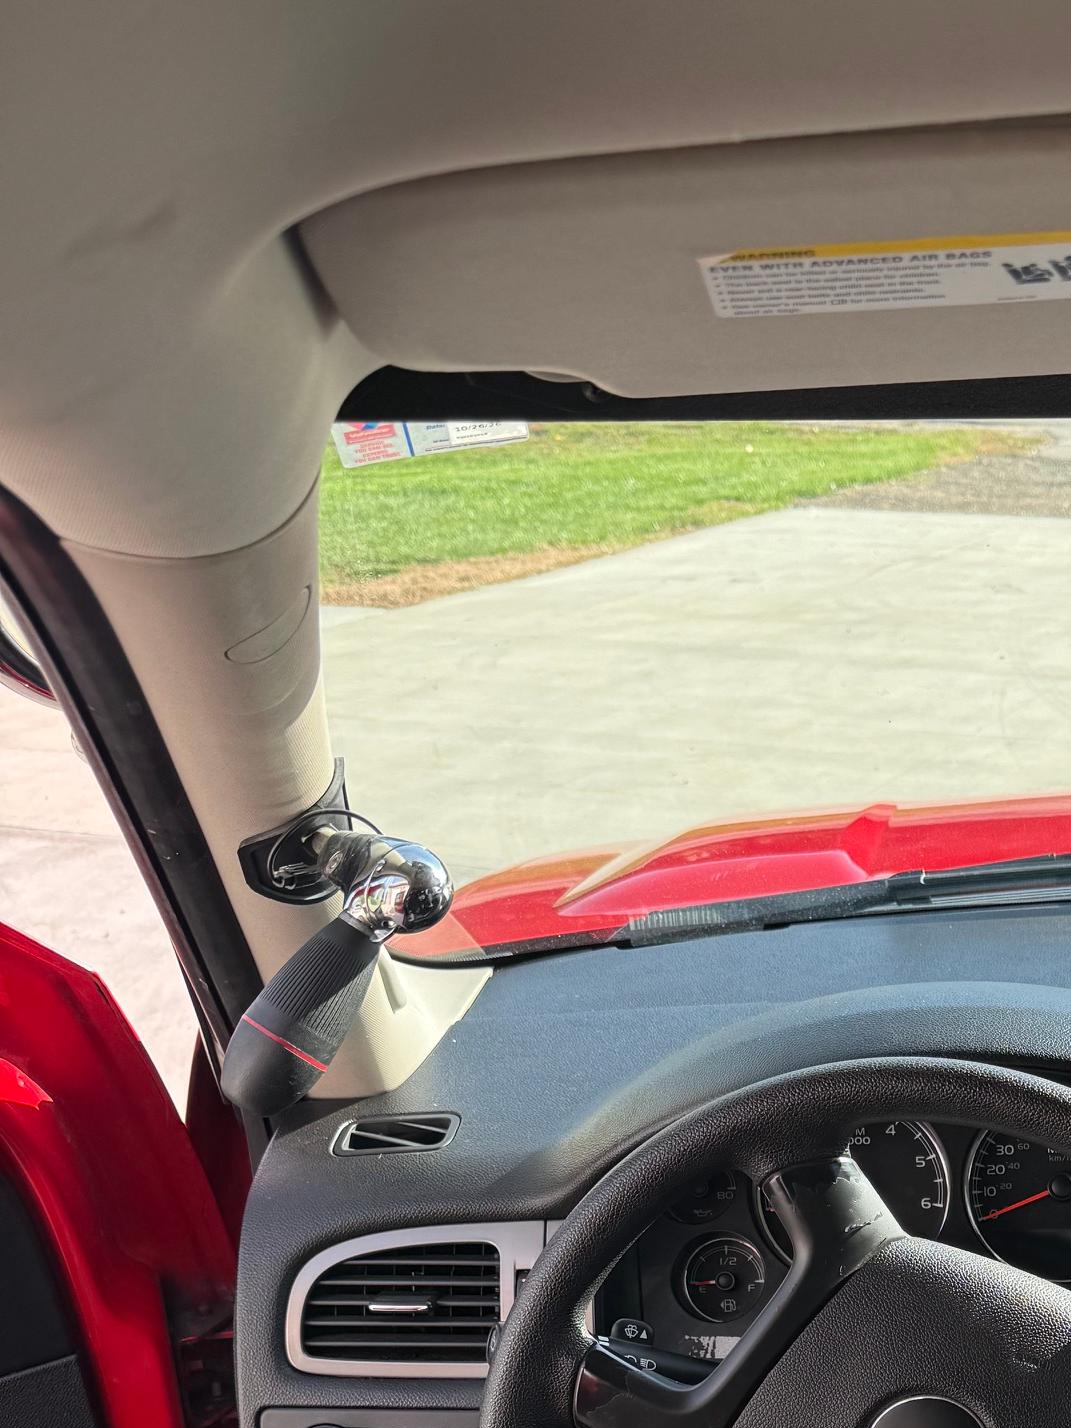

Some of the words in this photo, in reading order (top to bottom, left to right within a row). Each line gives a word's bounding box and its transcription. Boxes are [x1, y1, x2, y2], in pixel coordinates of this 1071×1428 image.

[709, 264, 754, 273] EVEN
[759, 261, 804, 271] WITH
[811, 256, 903, 269] ADVANCED
[910, 253, 939, 262] AIR
[945, 250, 993, 260] BAGS
[885, 1124, 897, 1136] 4
[996, 1144, 1014, 1156] 30
[915, 1156, 926, 1168] 5
[1007, 1162, 1020, 1170] 40
[986, 1164, 1005, 1175] 20
[983, 1186, 997, 1197] 10
[1000, 1182, 1013, 1190] 20
[920, 1197, 932, 1209] 6
[720, 1256, 737, 1266] 1/2
[747, 1284, 756, 1292] F
